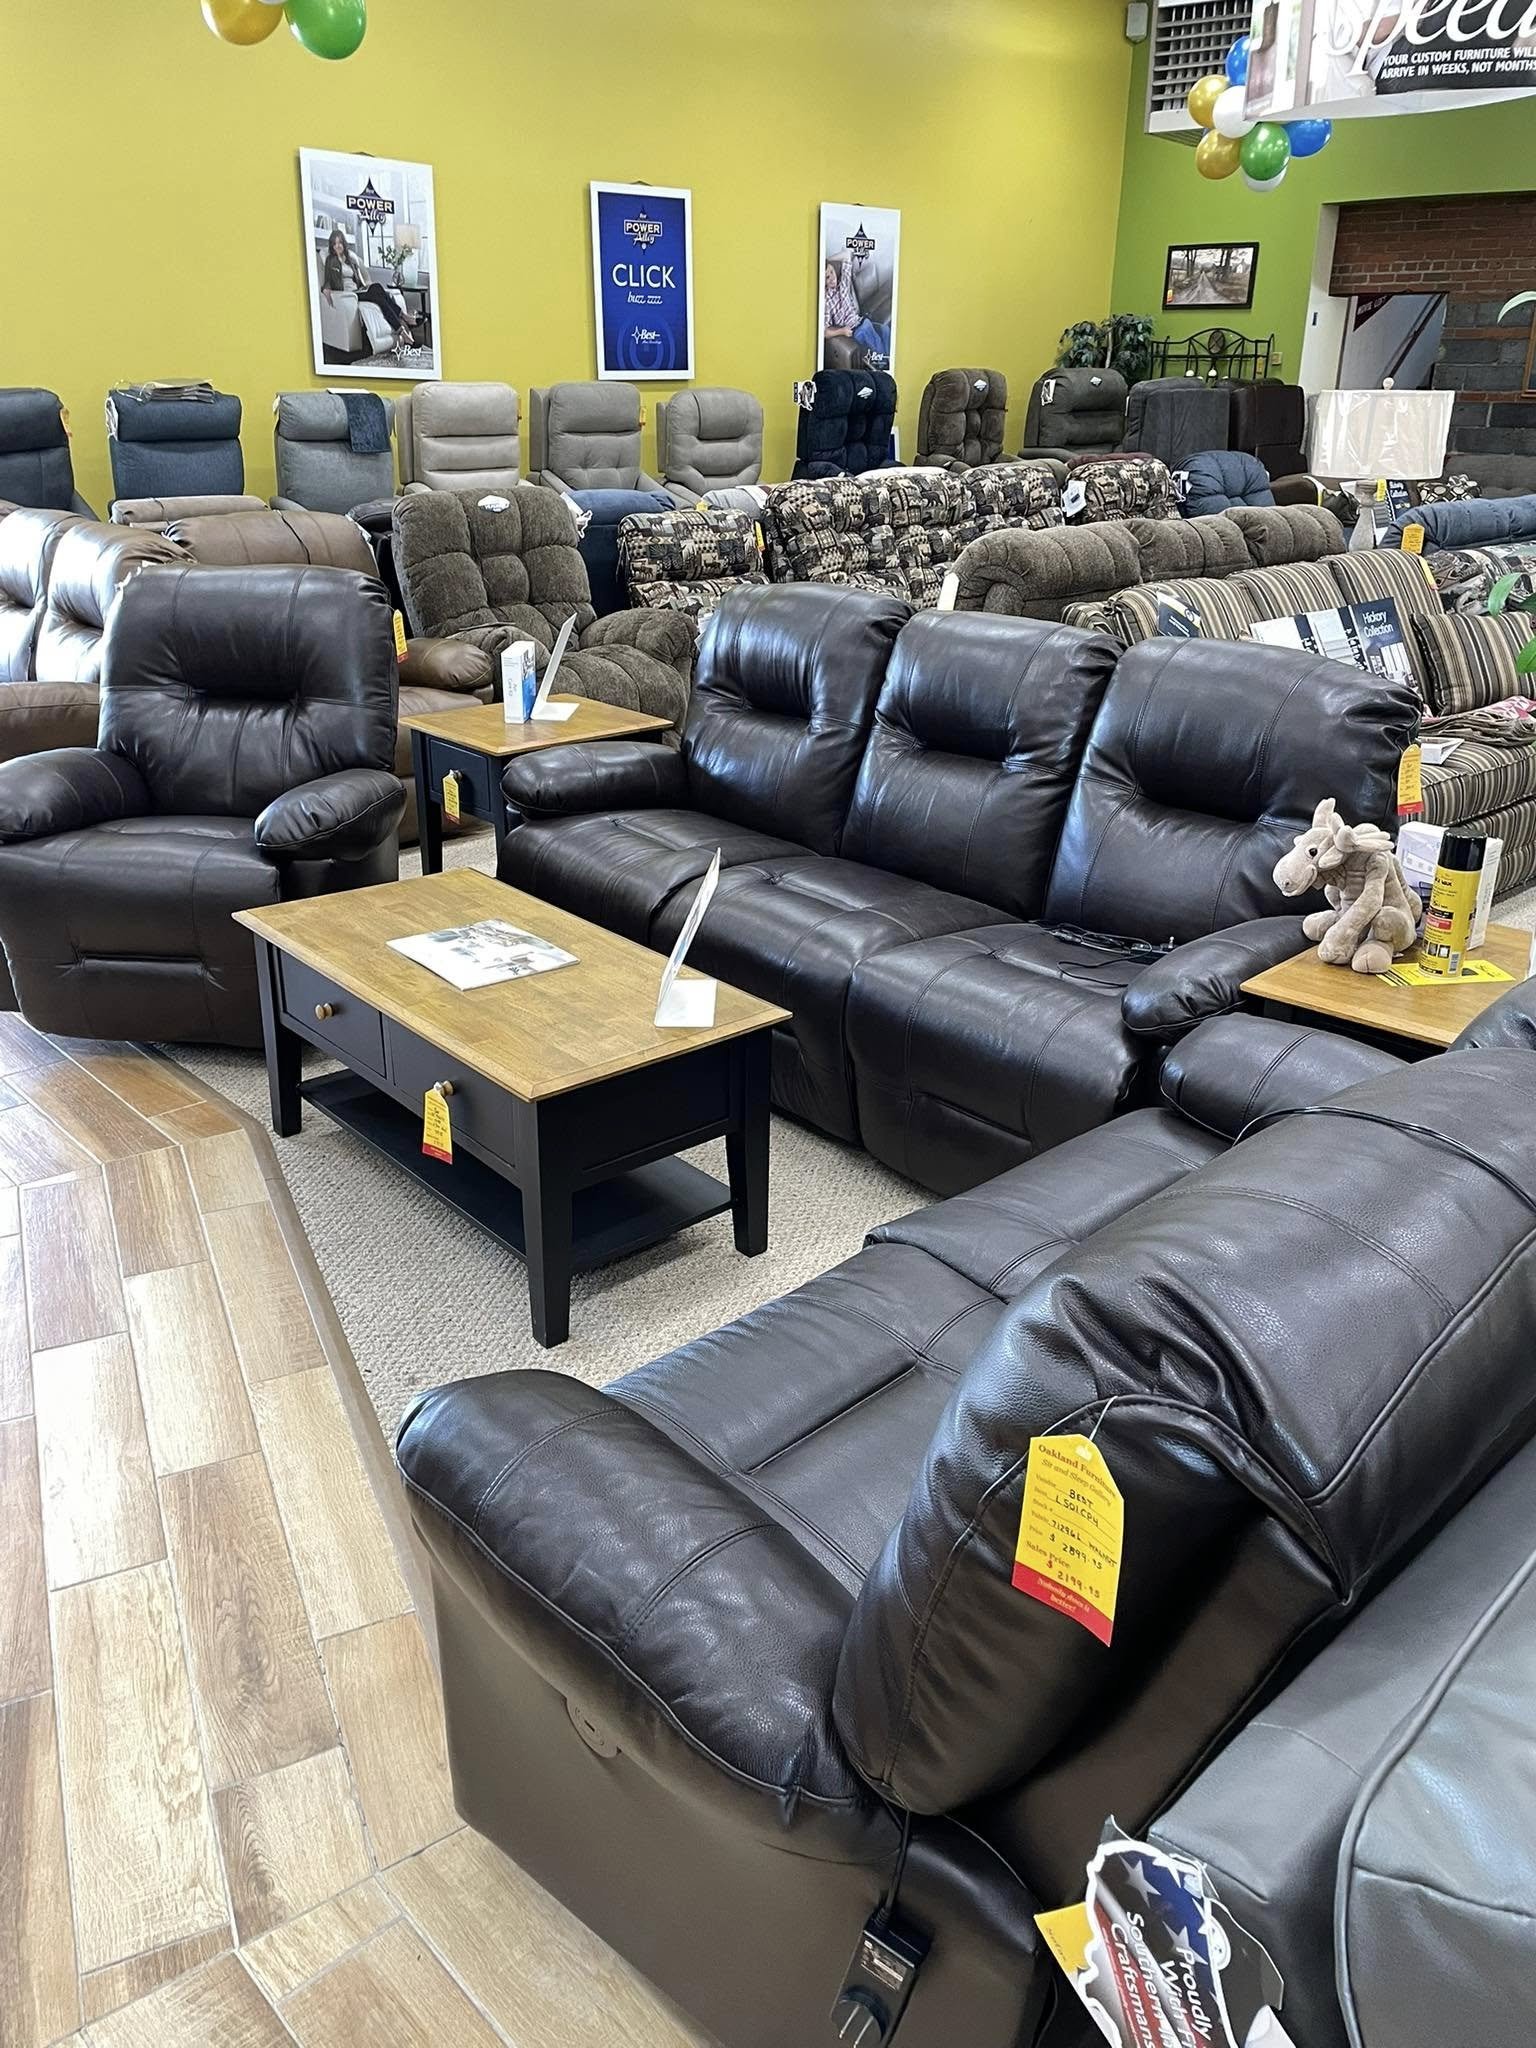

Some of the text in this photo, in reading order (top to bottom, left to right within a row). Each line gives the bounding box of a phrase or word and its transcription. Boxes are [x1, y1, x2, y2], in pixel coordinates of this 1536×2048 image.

[1382, 55, 1409, 67] YOUR
[1411, 50, 1452, 63] CUSTOM
[1454, 47, 1511, 61] FURNITURE
[1380, 65, 1415, 79] ARRIVE
[1417, 65, 1430, 76] IN
[1432, 62, 1470, 75] WEEKS,
[1471, 61, 1494, 73] NOT
[348, 196, 393, 213] POWER
[359, 207, 386, 224] Alley
[626, 222, 660, 234] POWER
[633, 231, 655, 246] Alley
[847, 239, 874, 249] POWER
[612, 263, 676, 289] CLICK
[627, 291, 646, 304] buzz
[640, 328, 657, 341] Best
[403, 344, 423, 357] Best
[871, 351, 885, 361] Best
[1362, 610, 1387, 624] Hickory
[1363, 623, 1394, 638] Collection
[1038, 1444, 1117, 1499] Oakland Furniture
[1053, 1465, 1069, 1477] and
[1069, 1471, 1089, 1488] Sleep
[1089, 1484, 1112, 1507] Gallery
[1069, 1489, 1094, 1509] BEST
[1026, 1540, 1048, 1557] Sales
[1126, 1911, 1162, 2019] Southern
[1111, 1922, 1156, 2048] Craftsmans
[1160, 1959, 1188, 2019] With
[1175, 1946, 1213, 2041] Proudly
